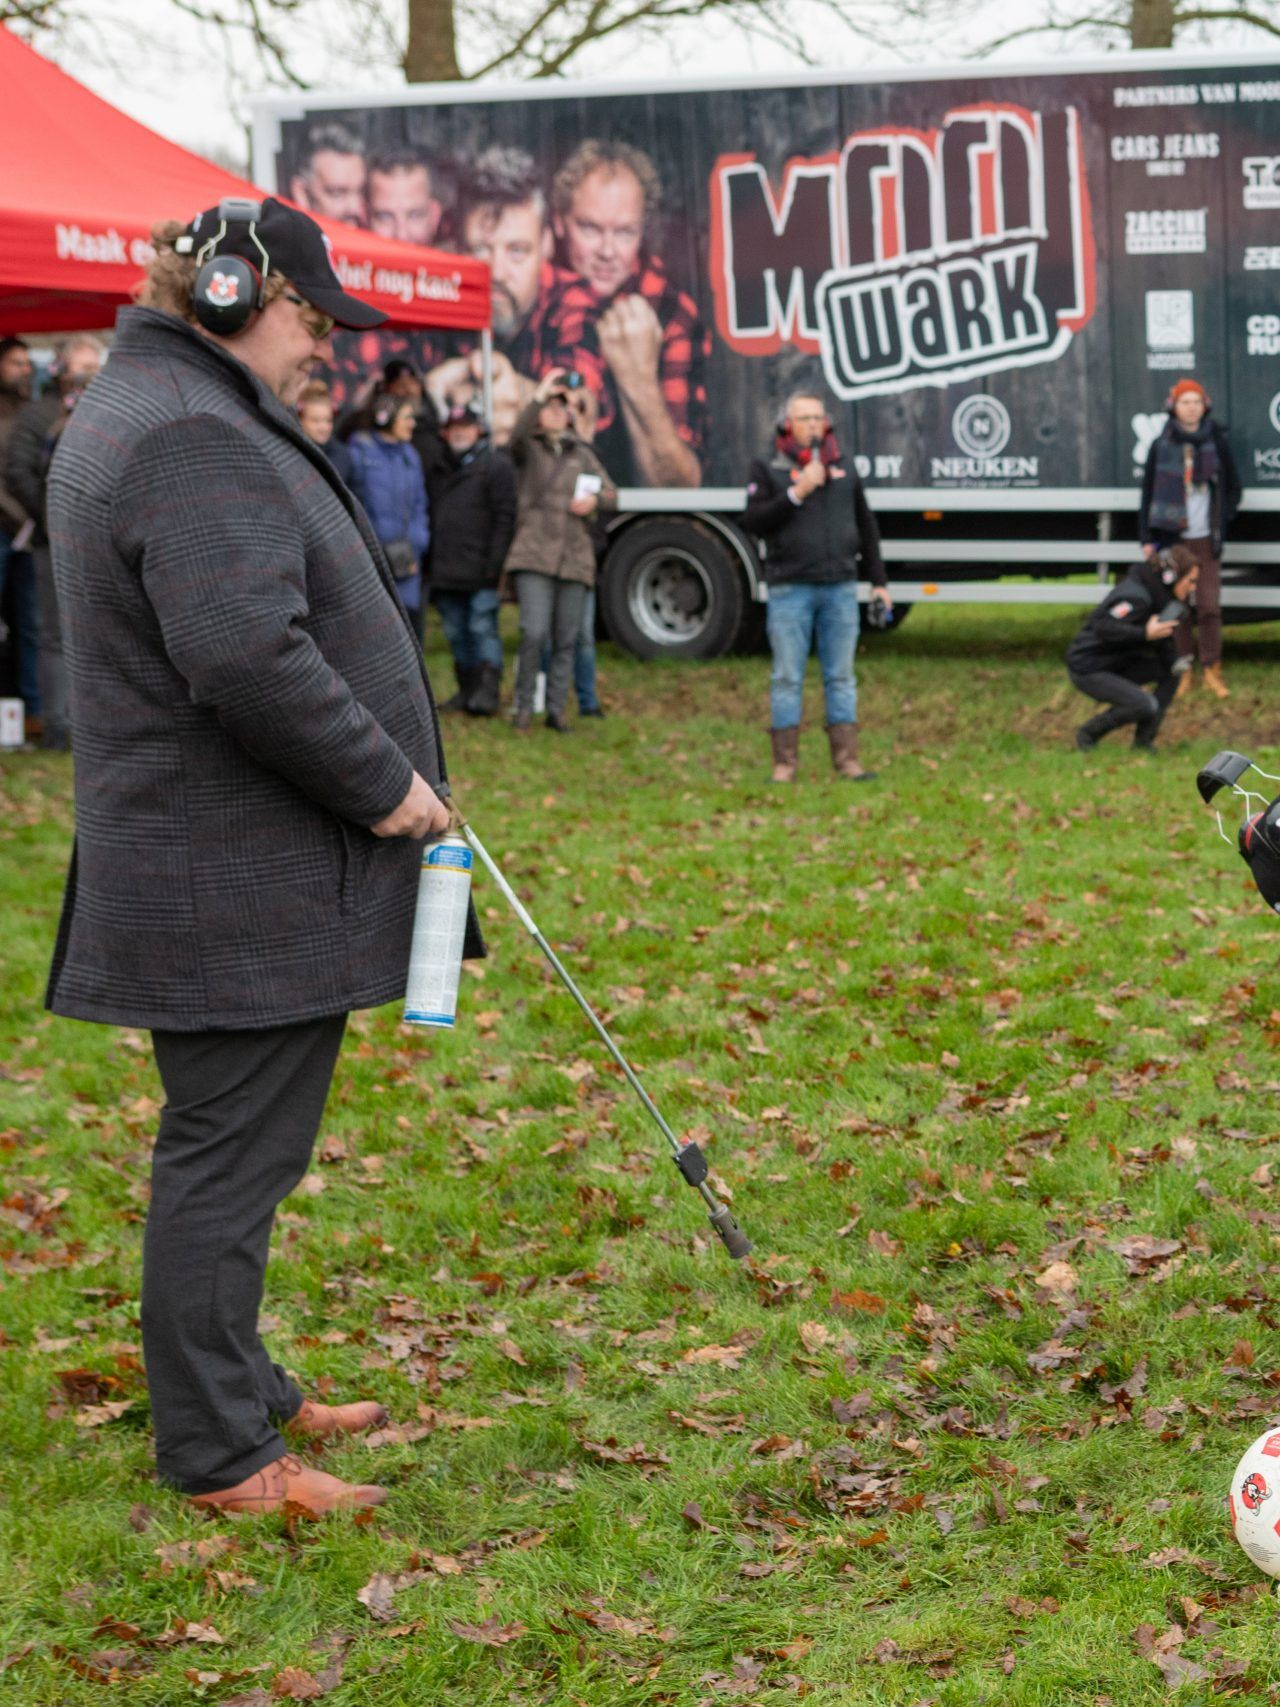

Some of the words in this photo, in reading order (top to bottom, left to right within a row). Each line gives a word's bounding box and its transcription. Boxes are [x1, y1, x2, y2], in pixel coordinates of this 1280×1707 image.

[1113, 85, 1199, 107] PARTNERS
[1200, 83, 1236, 103] VAN
[1111, 135, 1159, 161] CARS
[1163, 133, 1220, 158] JEANS
[1125, 210, 1206, 234] ZACCINI
[55, 223, 128, 265] Maak
[374, 268, 414, 304] nog
[875, 454, 902, 479] BY
[931, 456, 1039, 478] NEUKEN
